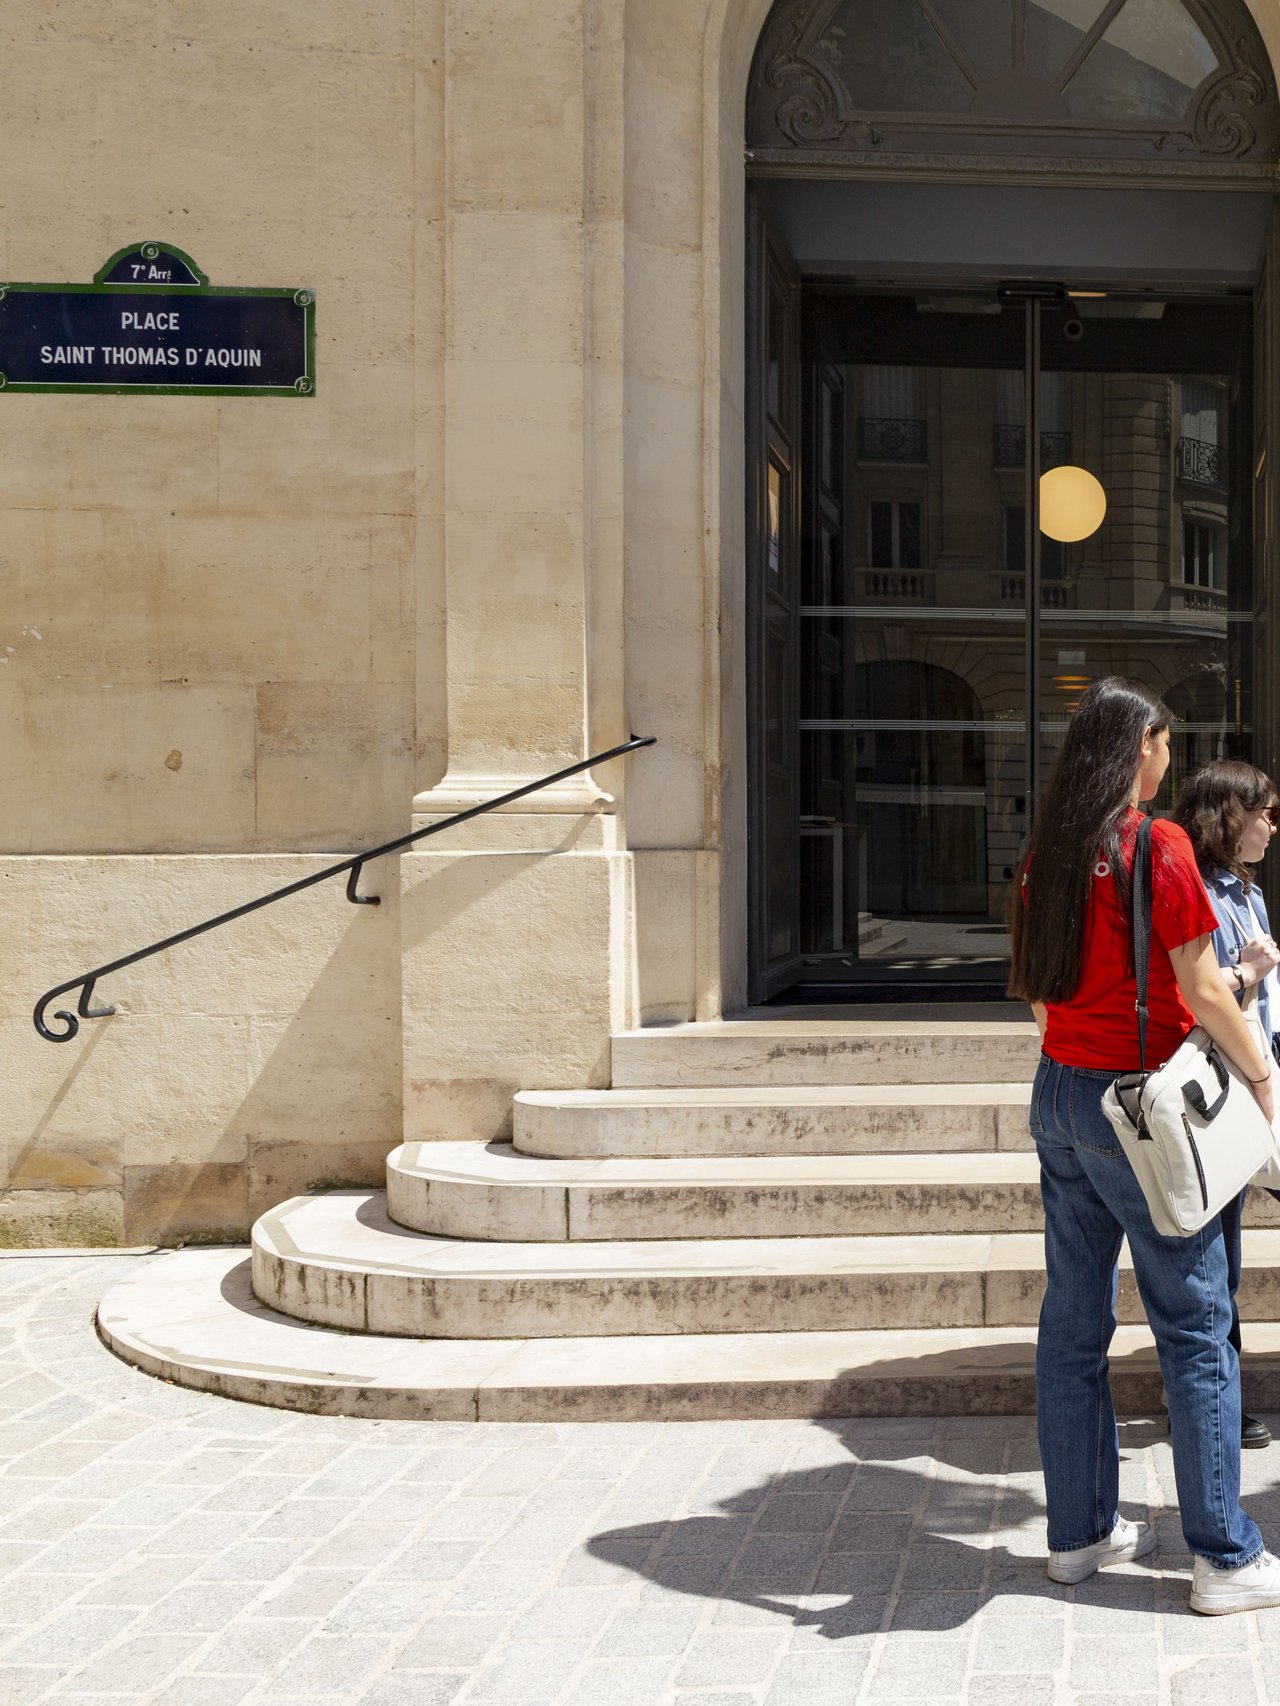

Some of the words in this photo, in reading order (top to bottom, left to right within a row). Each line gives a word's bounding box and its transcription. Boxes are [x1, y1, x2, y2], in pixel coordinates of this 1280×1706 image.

[121, 312, 180, 331] PLACE
[40, 346, 95, 364] SAINT
[102, 346, 179, 366] THOMAS
